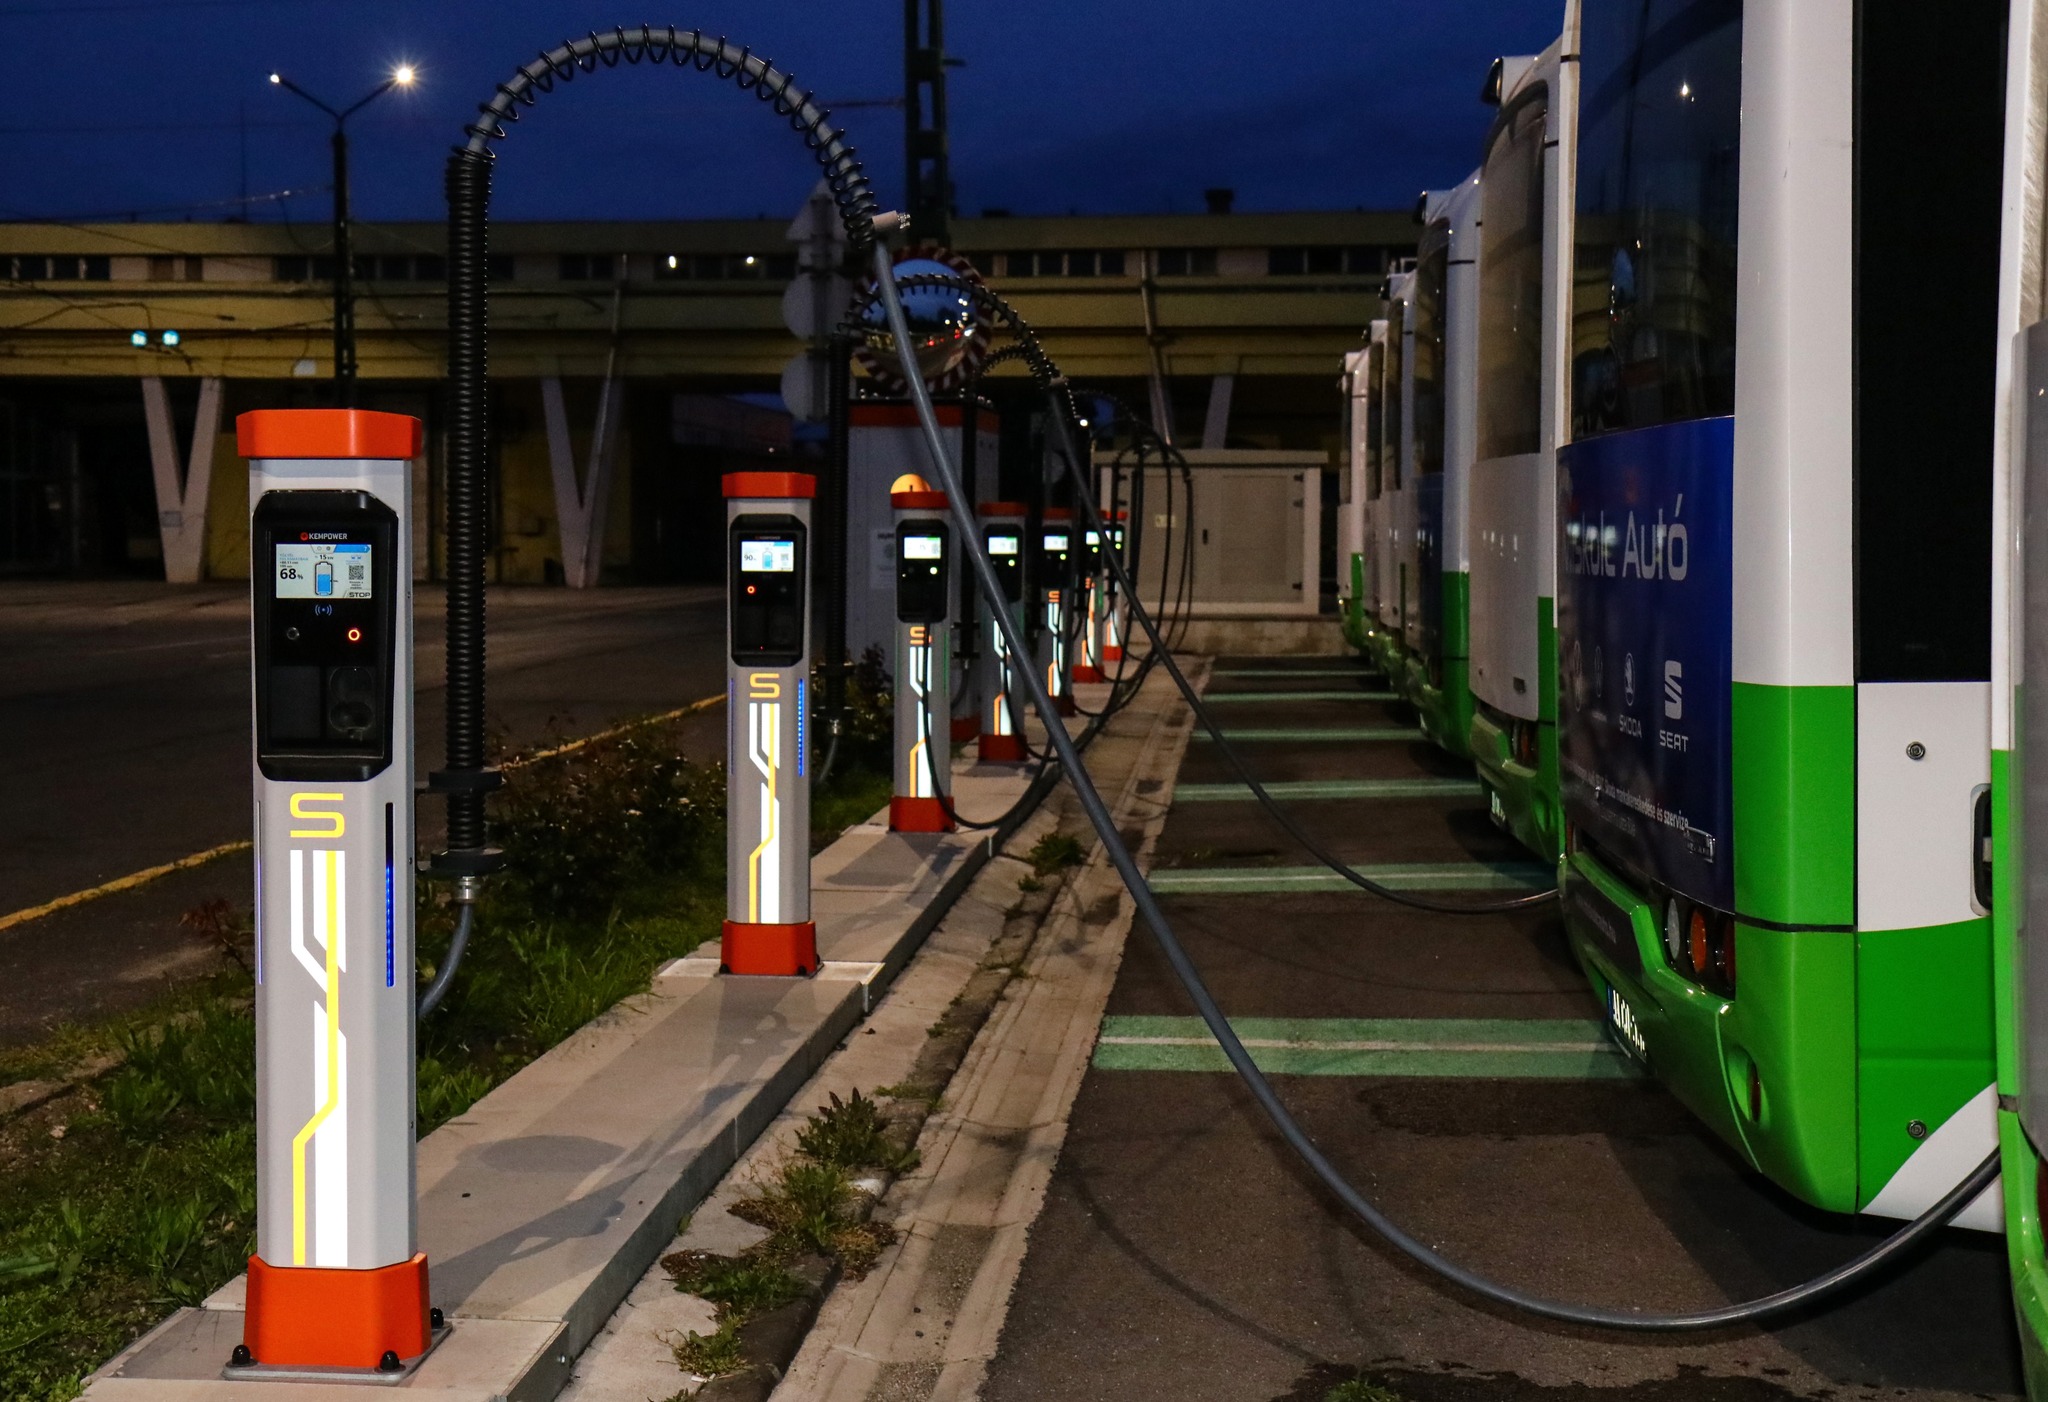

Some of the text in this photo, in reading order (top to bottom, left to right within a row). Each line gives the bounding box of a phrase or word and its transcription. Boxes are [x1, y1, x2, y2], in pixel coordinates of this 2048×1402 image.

[1622, 493, 1688, 581] Autó
[280, 568, 297, 580] 68
[749, 672, 781, 698] S
[1659, 729, 1689, 753] SEAT
[289, 792, 345, 839] S
